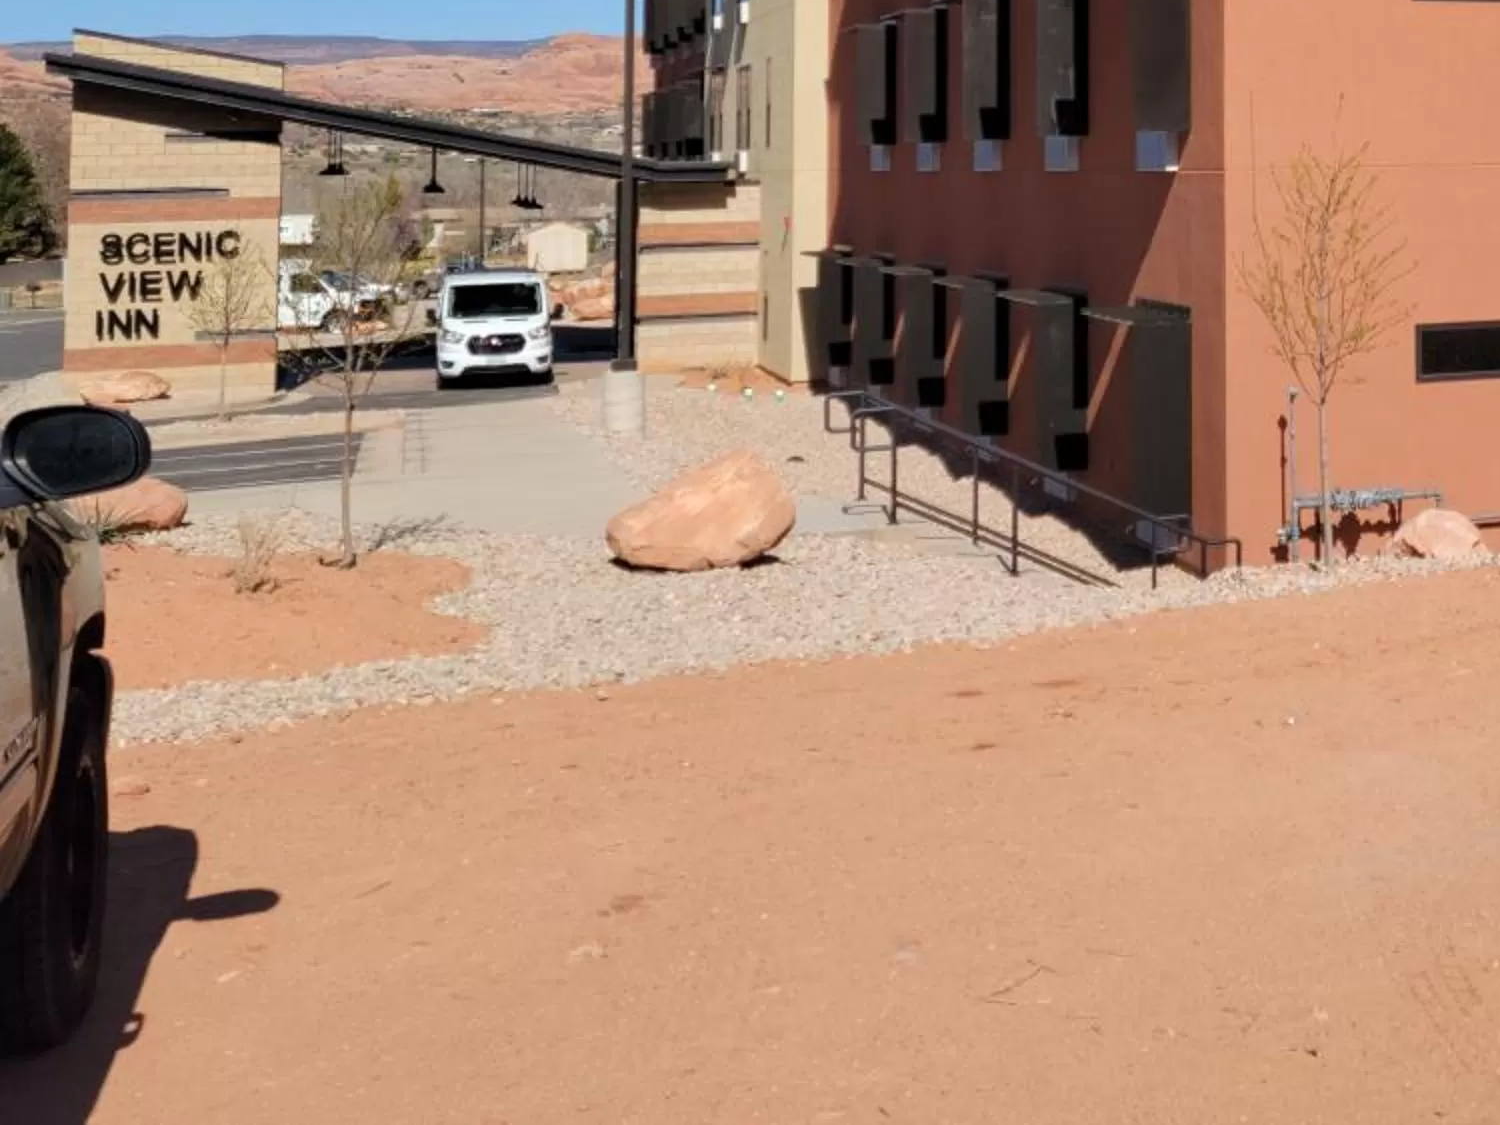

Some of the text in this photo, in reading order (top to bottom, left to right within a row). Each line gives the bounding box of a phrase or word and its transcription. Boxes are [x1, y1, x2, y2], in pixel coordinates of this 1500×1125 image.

[100, 230, 241, 265] SCENIC
[98, 270, 203, 304] VIEW
[95, 308, 160, 342] INN
